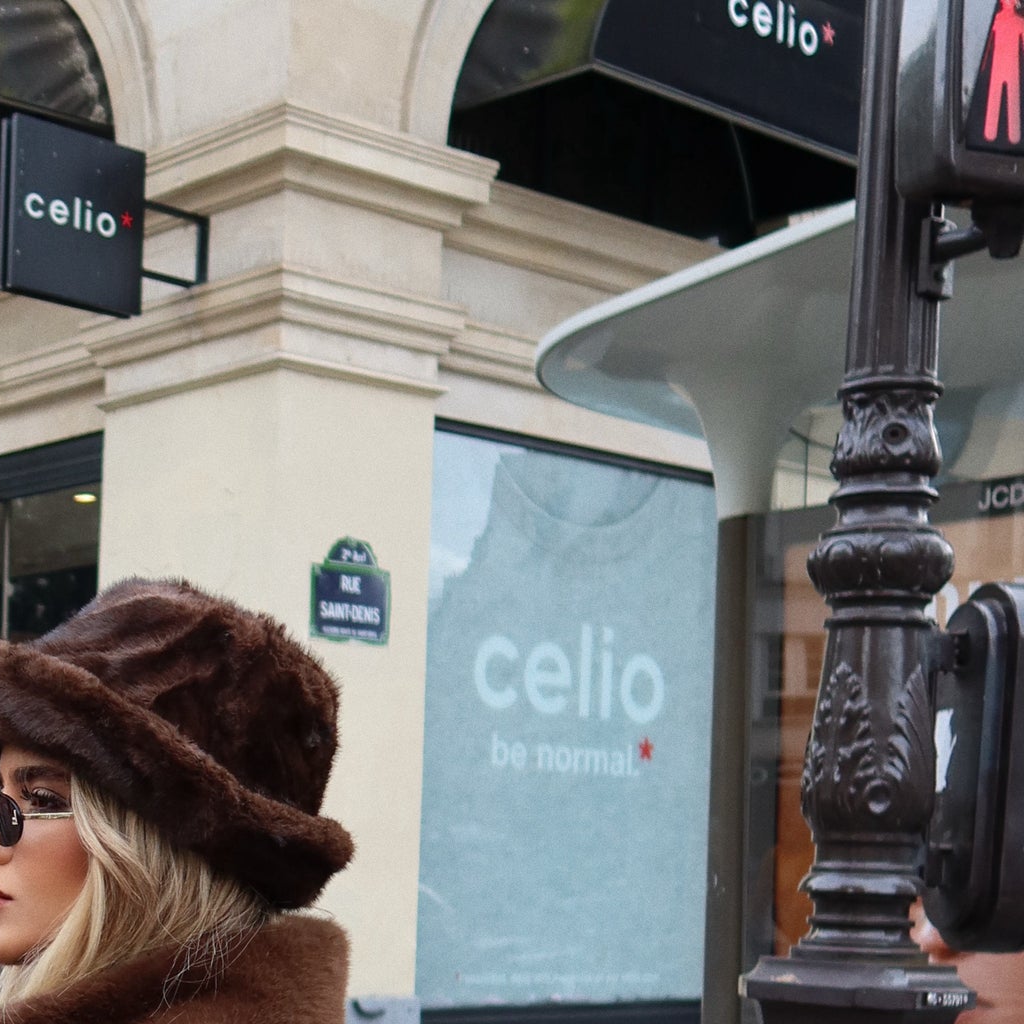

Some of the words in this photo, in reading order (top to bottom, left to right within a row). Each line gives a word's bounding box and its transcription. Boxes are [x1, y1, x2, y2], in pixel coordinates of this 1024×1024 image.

[728, 0, 819, 56] celio
[24, 192, 116, 238] celio
[340, 574, 361, 595] RUE
[320, 600, 380, 625] SAINT-DENIS
[474, 622, 665, 724] celio
[491, 732, 526, 769] be
